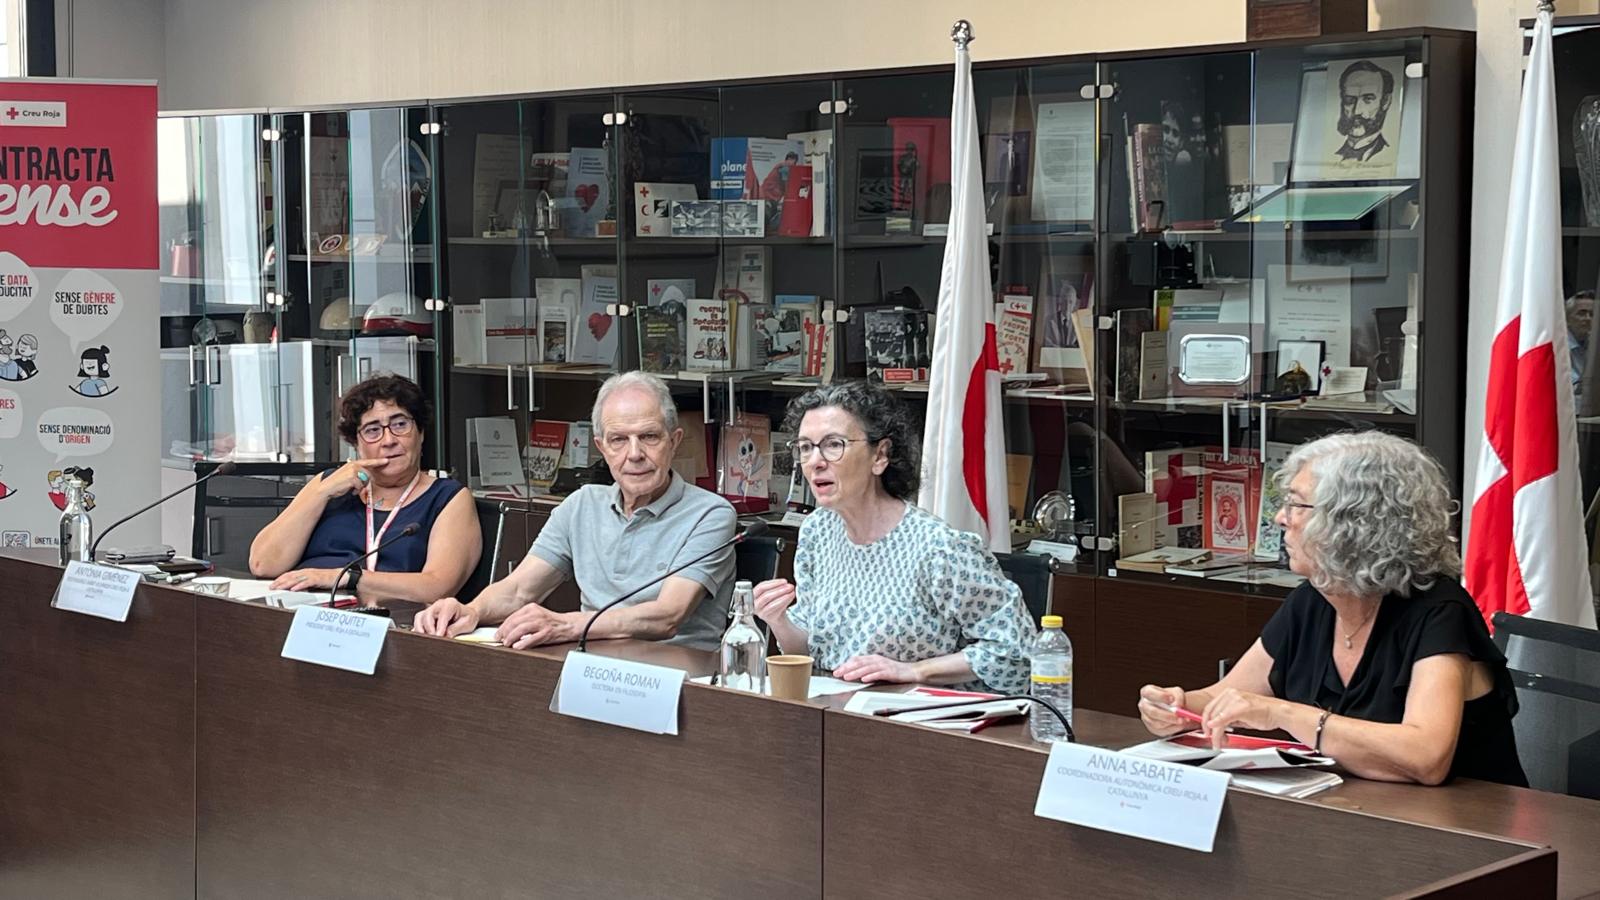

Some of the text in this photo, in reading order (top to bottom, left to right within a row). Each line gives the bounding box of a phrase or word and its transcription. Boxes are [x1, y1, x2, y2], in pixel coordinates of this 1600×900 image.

[43, 110, 60, 118] Roja
[7, 275, 29, 286] DATA
[54, 291, 116, 304] SENSE GÈNERE
[63, 304, 109, 315] DE DUBTES
[39, 424, 111, 435] SENSE DENOMINACIÓ
[315, 610, 368, 628] JOSEP QUITET
[583, 665, 662, 690] BEGOÑA ROMAN
[1087, 754, 1184, 784] ANNA SABATÉ
